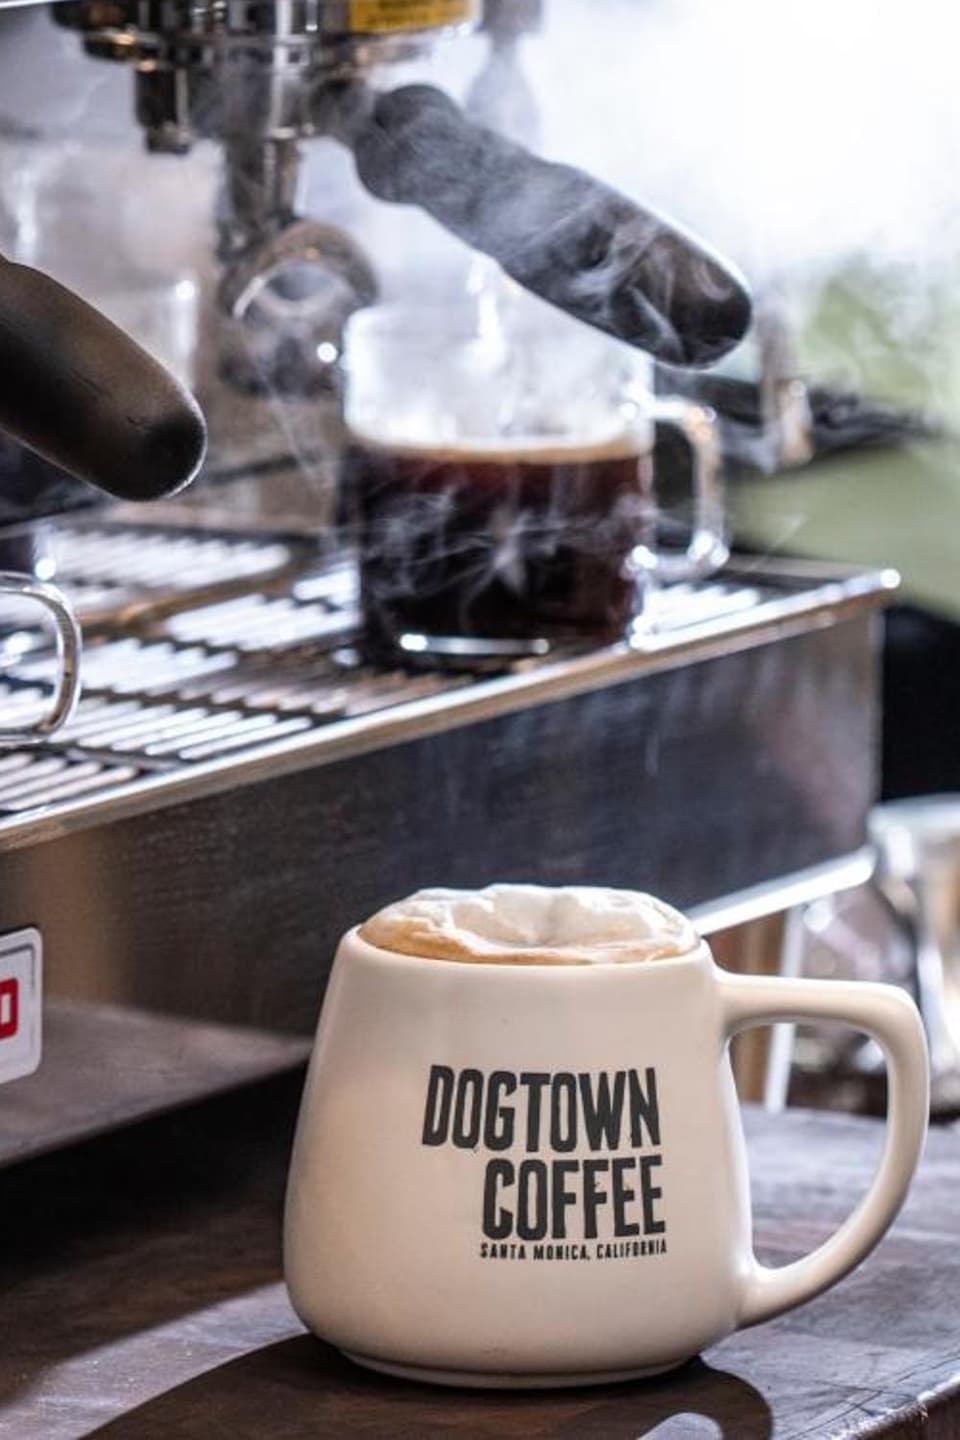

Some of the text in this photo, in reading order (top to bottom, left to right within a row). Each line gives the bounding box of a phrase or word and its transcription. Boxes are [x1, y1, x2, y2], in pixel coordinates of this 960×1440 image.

[422, 1064, 661, 1152] DOGTOWN
[482, 1154, 666, 1241] COFFEE
[480, 1243, 527, 1260] SANTA
[596, 1239, 668, 1259] CALIFORNIA
